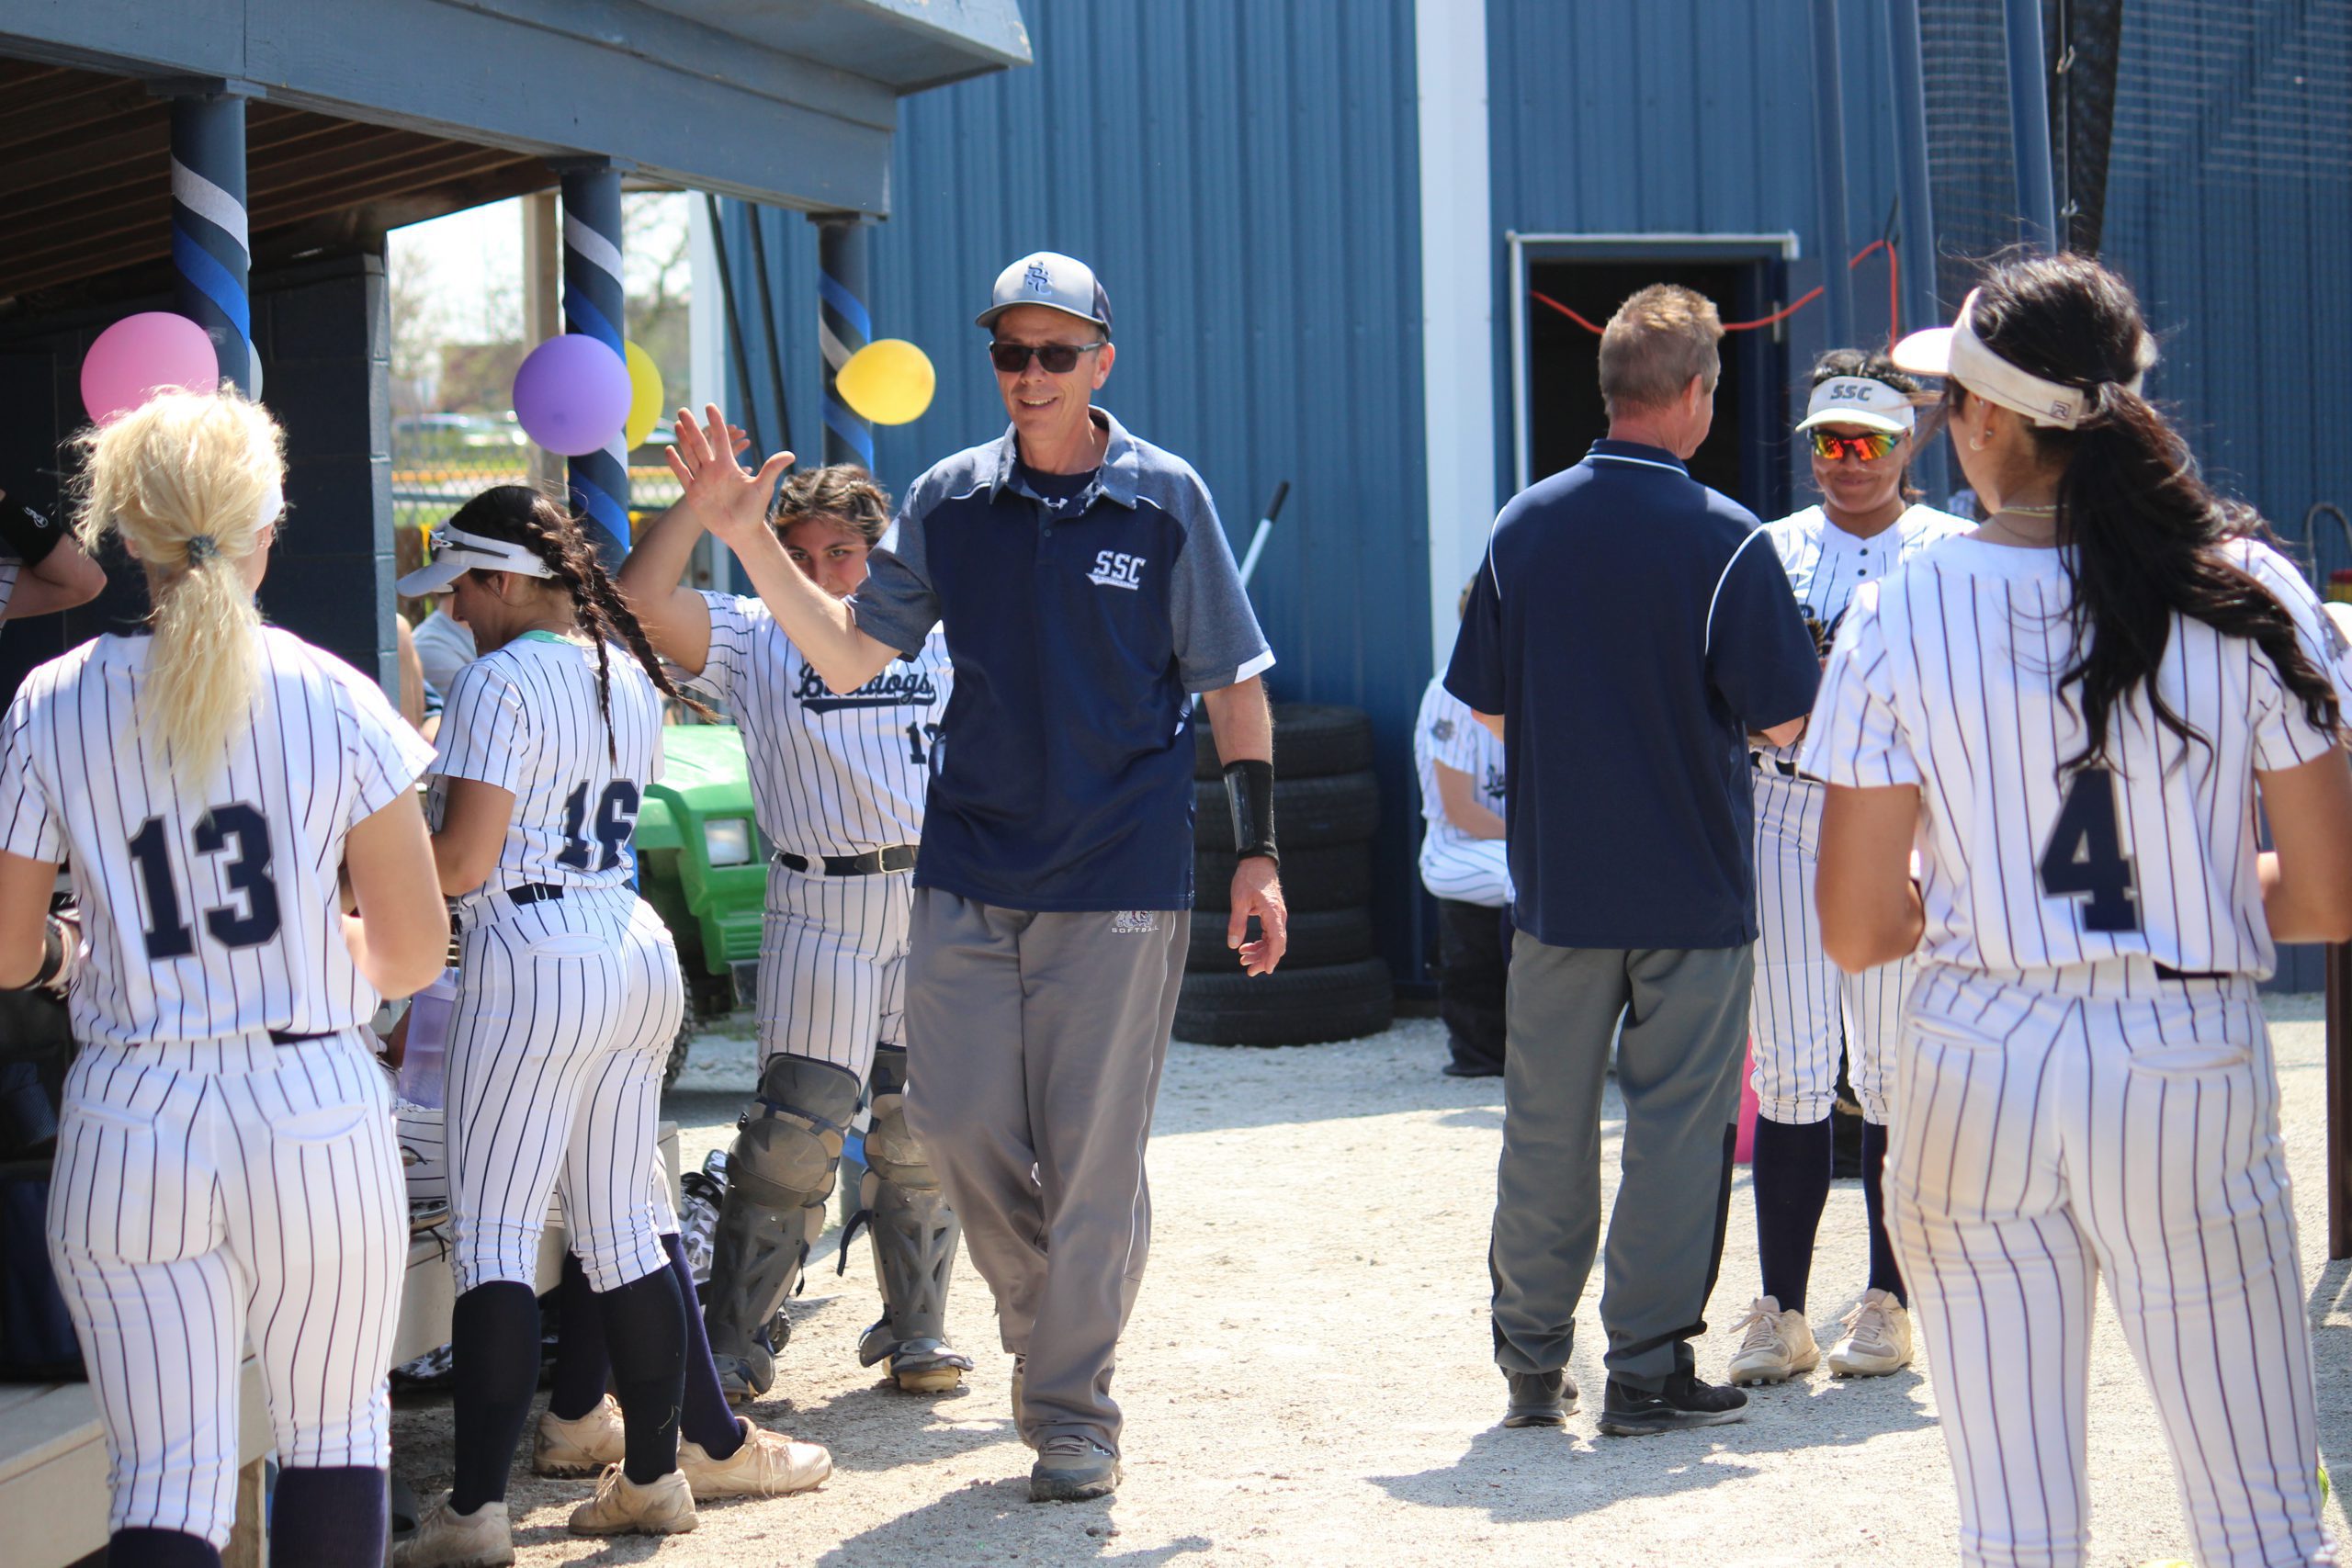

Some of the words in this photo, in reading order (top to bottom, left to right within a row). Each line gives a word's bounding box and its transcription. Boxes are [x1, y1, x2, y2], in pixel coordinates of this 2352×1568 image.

[1830, 384, 1872, 401] SSC
[1092, 550, 1147, 584] SSC
[792, 661, 936, 705] Bdogs
[555, 778, 639, 873] 16
[2036, 766, 2143, 933] 4
[127, 799, 282, 962] 13
[1111, 924, 1160, 934] SOFTBAL
